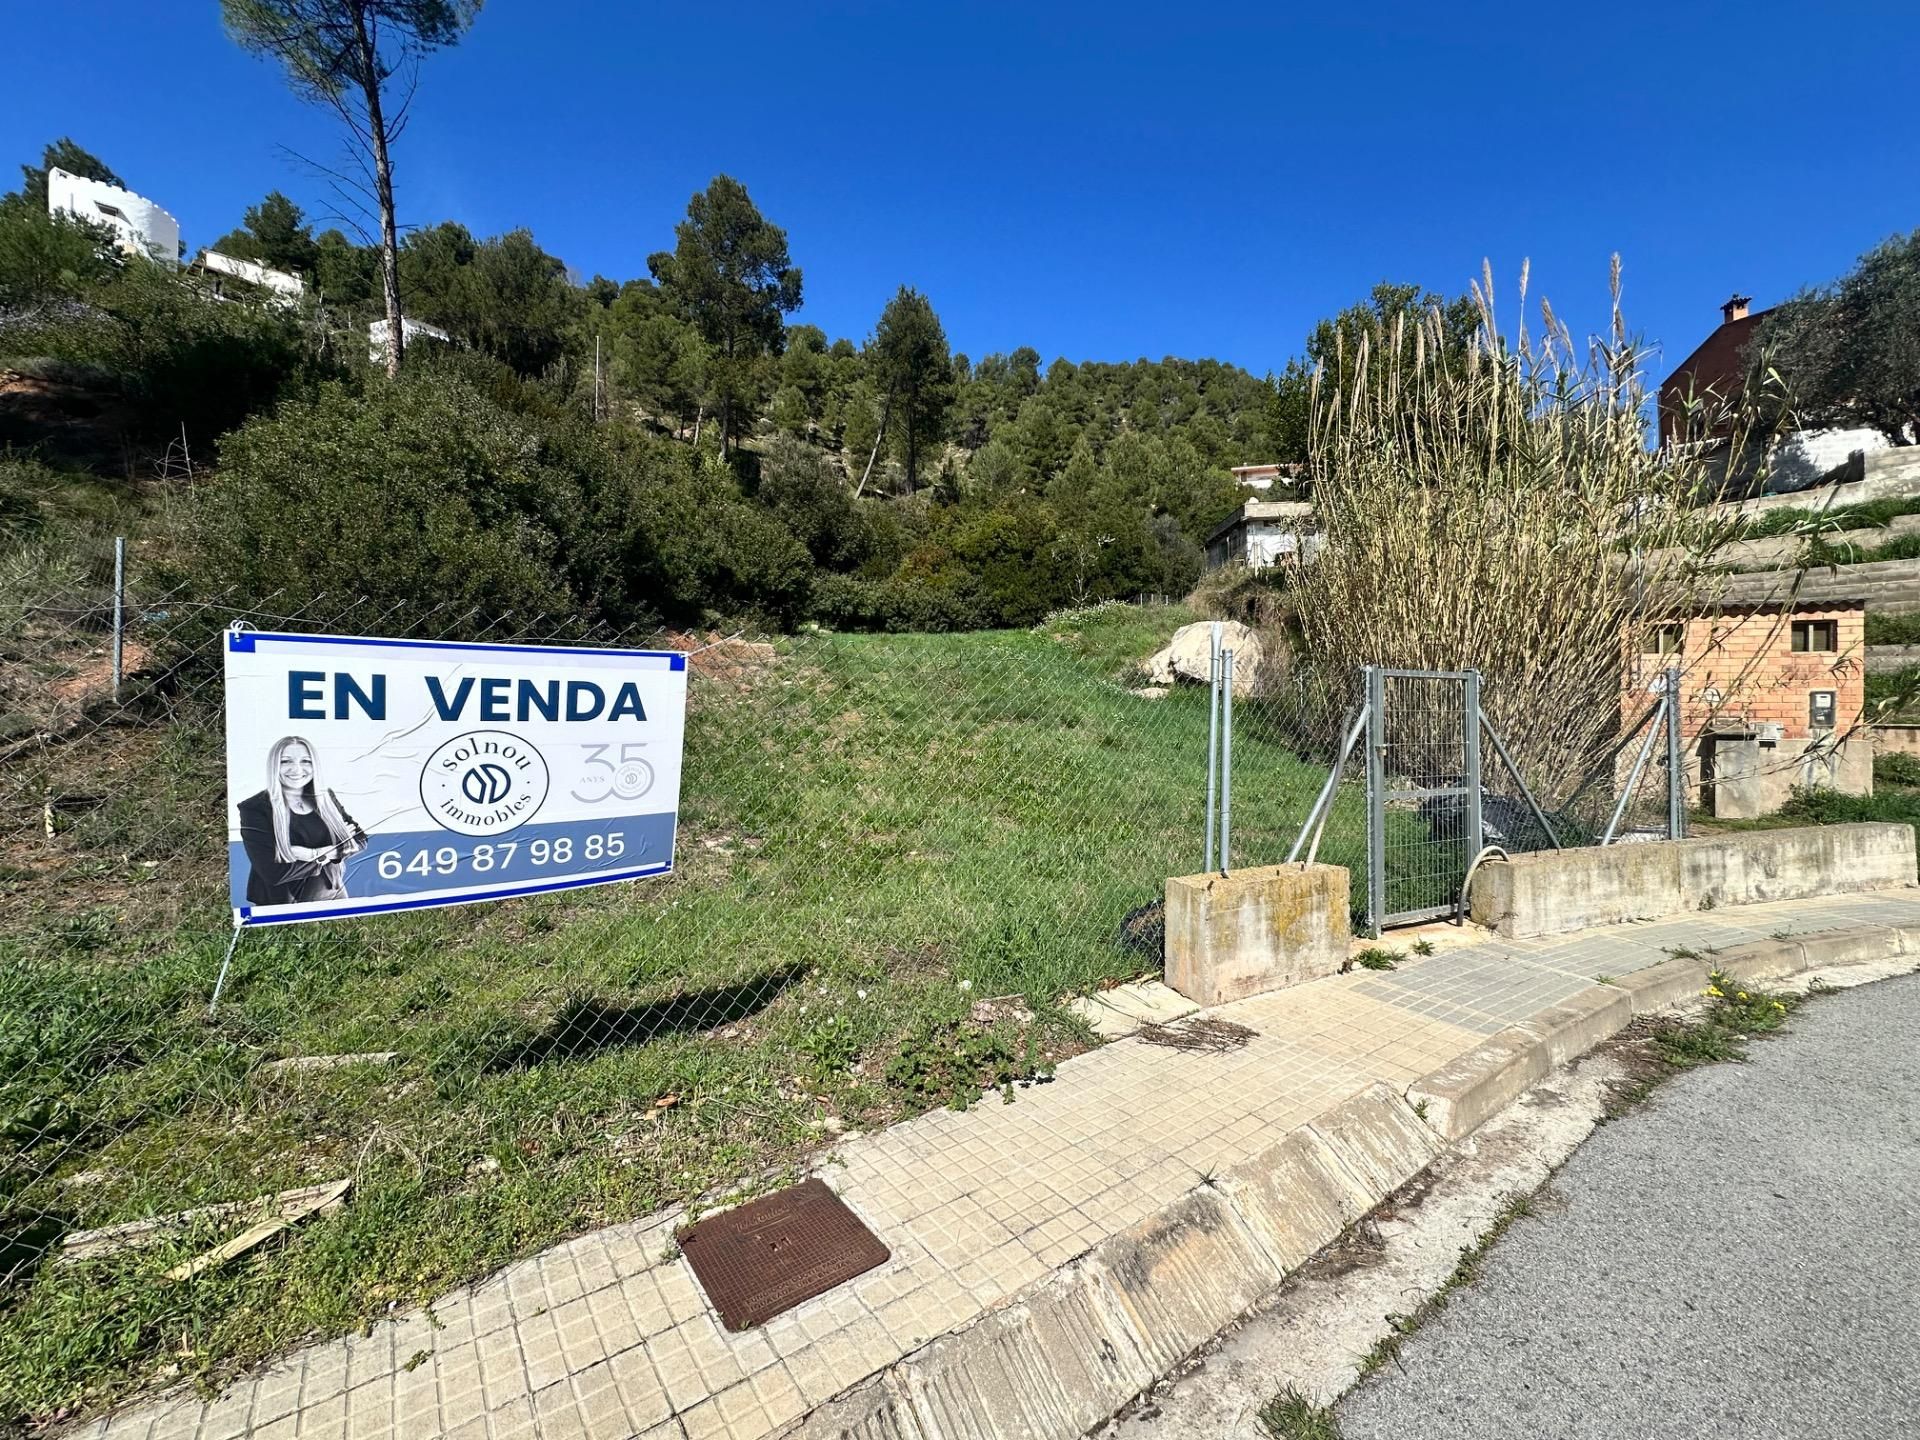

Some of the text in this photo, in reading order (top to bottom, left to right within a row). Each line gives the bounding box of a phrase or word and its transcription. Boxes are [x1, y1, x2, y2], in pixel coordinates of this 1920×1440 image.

[288, 670, 647, 721] EN VENDA
[442, 737, 531, 771] solnou
[570, 743, 655, 803] 35
[440, 798, 532, 826] immobles
[377, 832, 625, 880] 649 87 98 85
